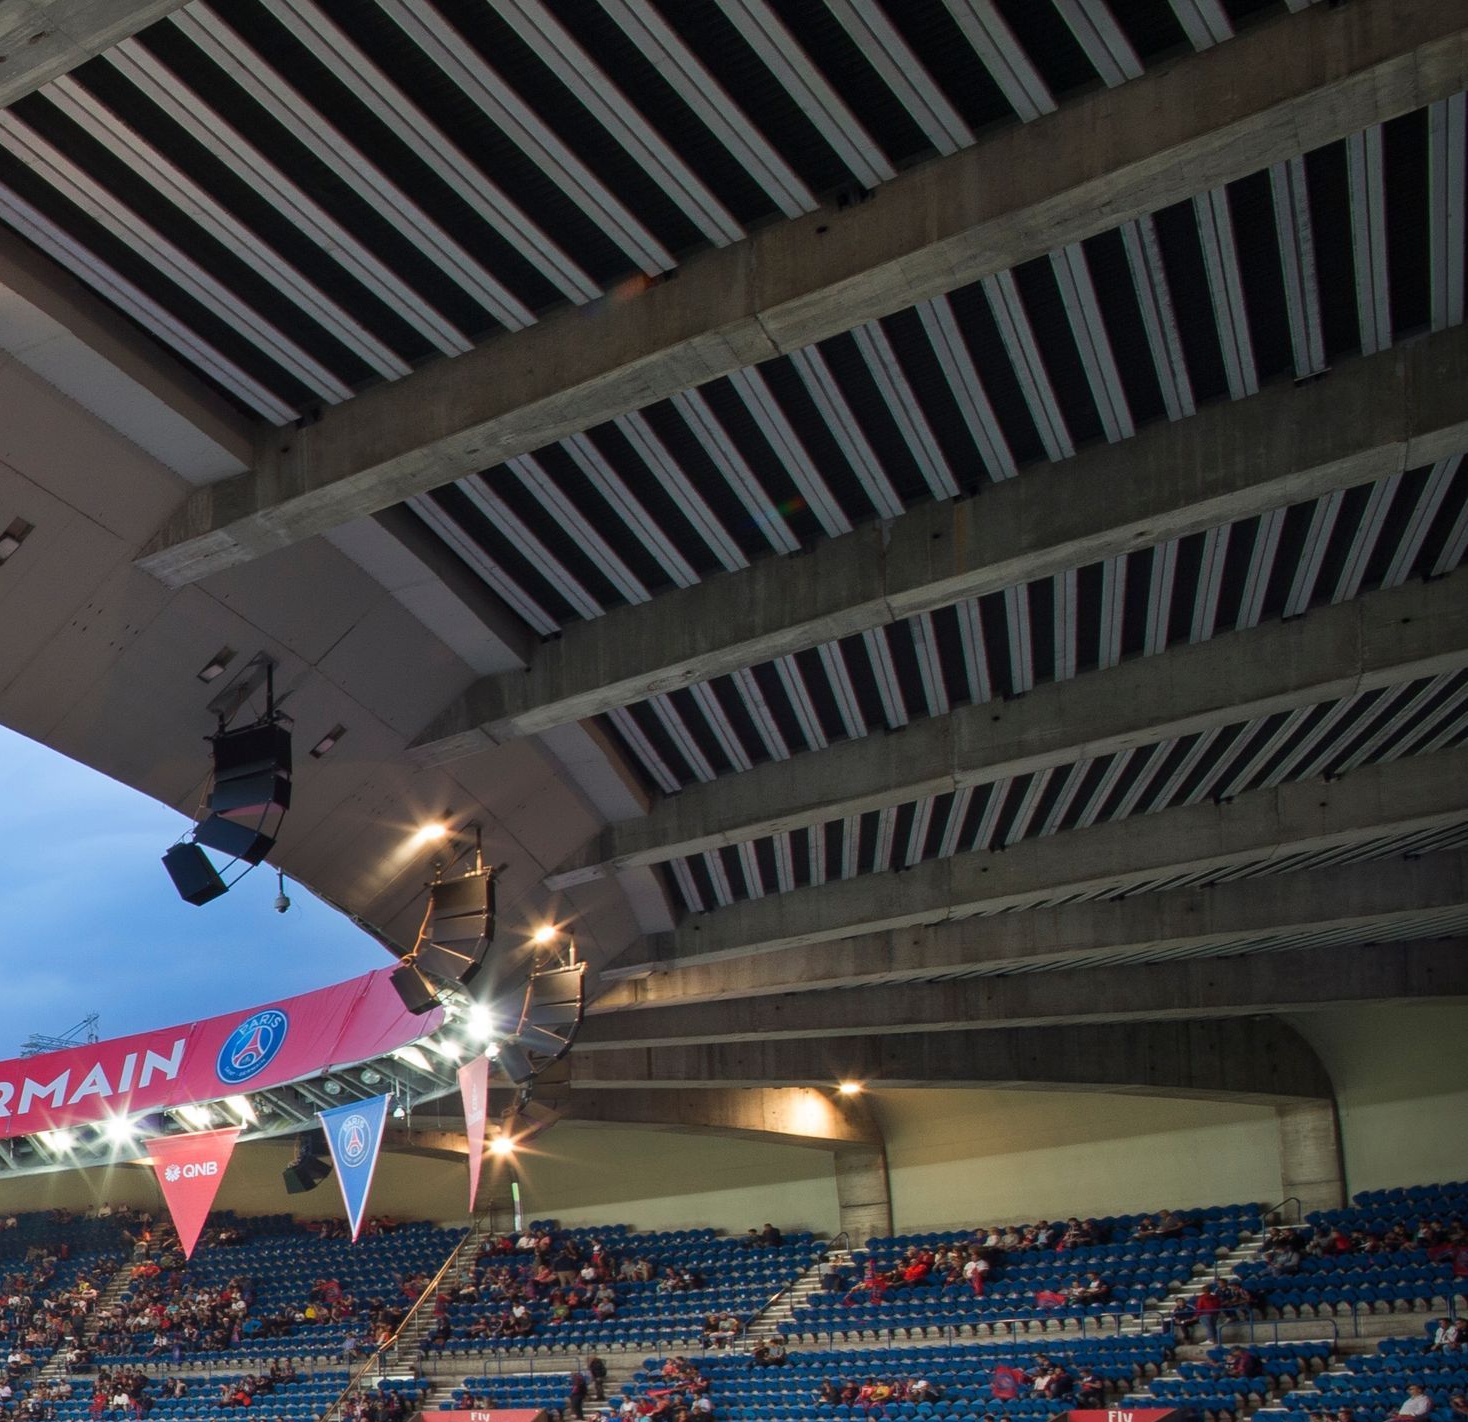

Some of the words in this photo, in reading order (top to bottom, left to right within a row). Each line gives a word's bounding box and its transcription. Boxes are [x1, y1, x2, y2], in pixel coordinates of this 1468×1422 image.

[238, 1013, 281, 1034] PARIS
[183, 1161, 218, 1178] QNB
[470, 1411, 491, 1422] Fly
